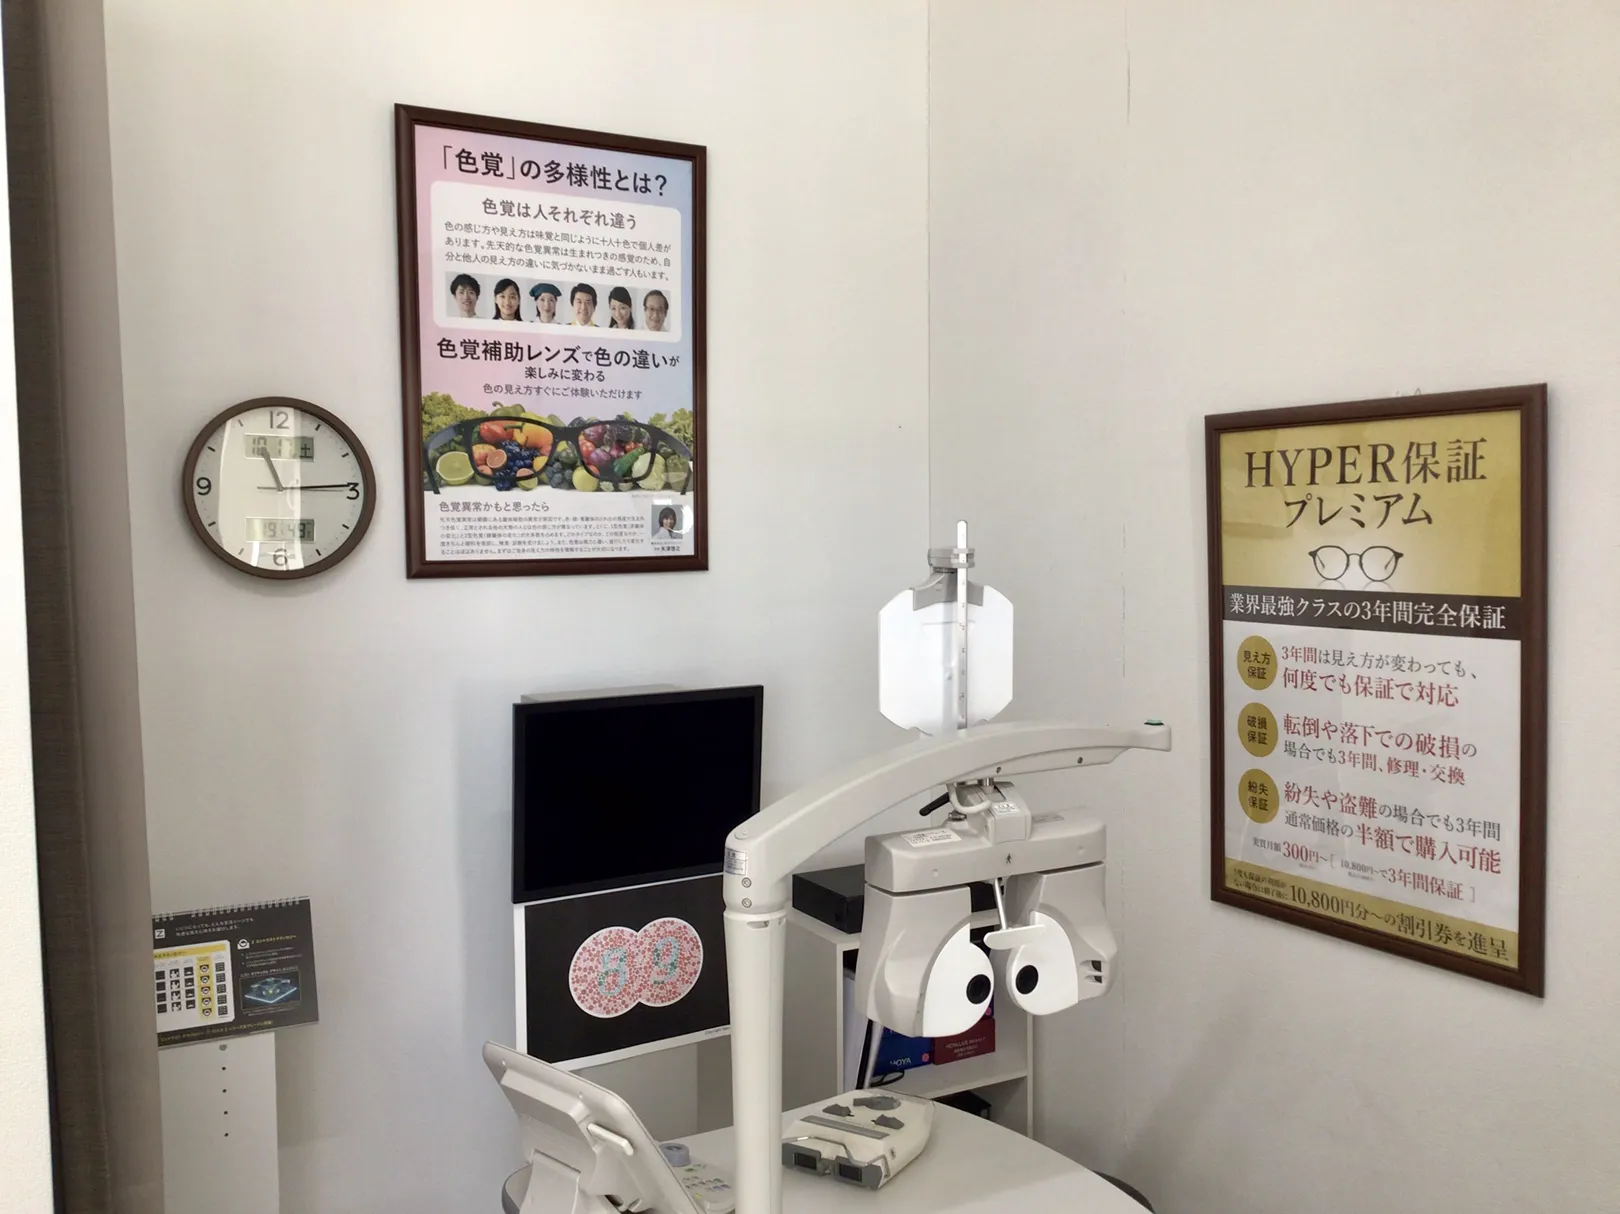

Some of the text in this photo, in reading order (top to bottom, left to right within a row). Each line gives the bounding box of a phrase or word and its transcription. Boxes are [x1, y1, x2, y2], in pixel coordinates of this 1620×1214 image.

[442, 144, 669, 197] 「色覚」の多様性とは？
[482, 197, 637, 231] 色覚は人それぞれ違う
[444, 221, 671, 253] 色の感じ方や見え方は味覚と同じように十人十色で個人差が
[444, 236, 671, 268] あります。先天的な色覚異常は生まれつきの感覚のため、自
[445, 252, 670, 281] 分と他人の見え方の違いに気づかないまま過ごす人もいます。
[437, 337, 680, 369] 色覚補助レンズで色の違いが
[524, 366, 605, 382] 楽しみに変わる
[483, 383, 642, 400] 色の見え方すぐにご体験いただけます
[269, 410, 290, 429] 12
[1244, 437, 1488, 488] HYPER保証
[196, 477, 212, 496] 9
[346, 482, 360, 500] 3
[439, 500, 550, 513] 色覚異常かもと思ったら
[1283, 492, 1434, 530] プレミアム
[273, 548, 288, 567] 6
[1229, 593, 1506, 630] 業界最強クラスの3年間完全保証
[1243, 650, 1271, 665] 見え方
[1281, 645, 1478, 680] 3年間は見え方が変わっても、
[1247, 667, 1267, 680] 保証
[1281, 667, 1459, 707] 何度でも保証で対応
[1246, 715, 1268, 730] 破損
[1283, 714, 1478, 761] 転倒や落下での破損の
[1247, 731, 1268, 746] 保証
[1283, 741, 1466, 786] 場合でも3年間、修理・交換
[1247, 780, 1269, 796] 紛失
[1248, 797, 1268, 812] 保証
[1283, 781, 1501, 842] 紛失や盗難の場合でも3年間
[1284, 809, 1502, 875] 通常価格の半額で購入可能
